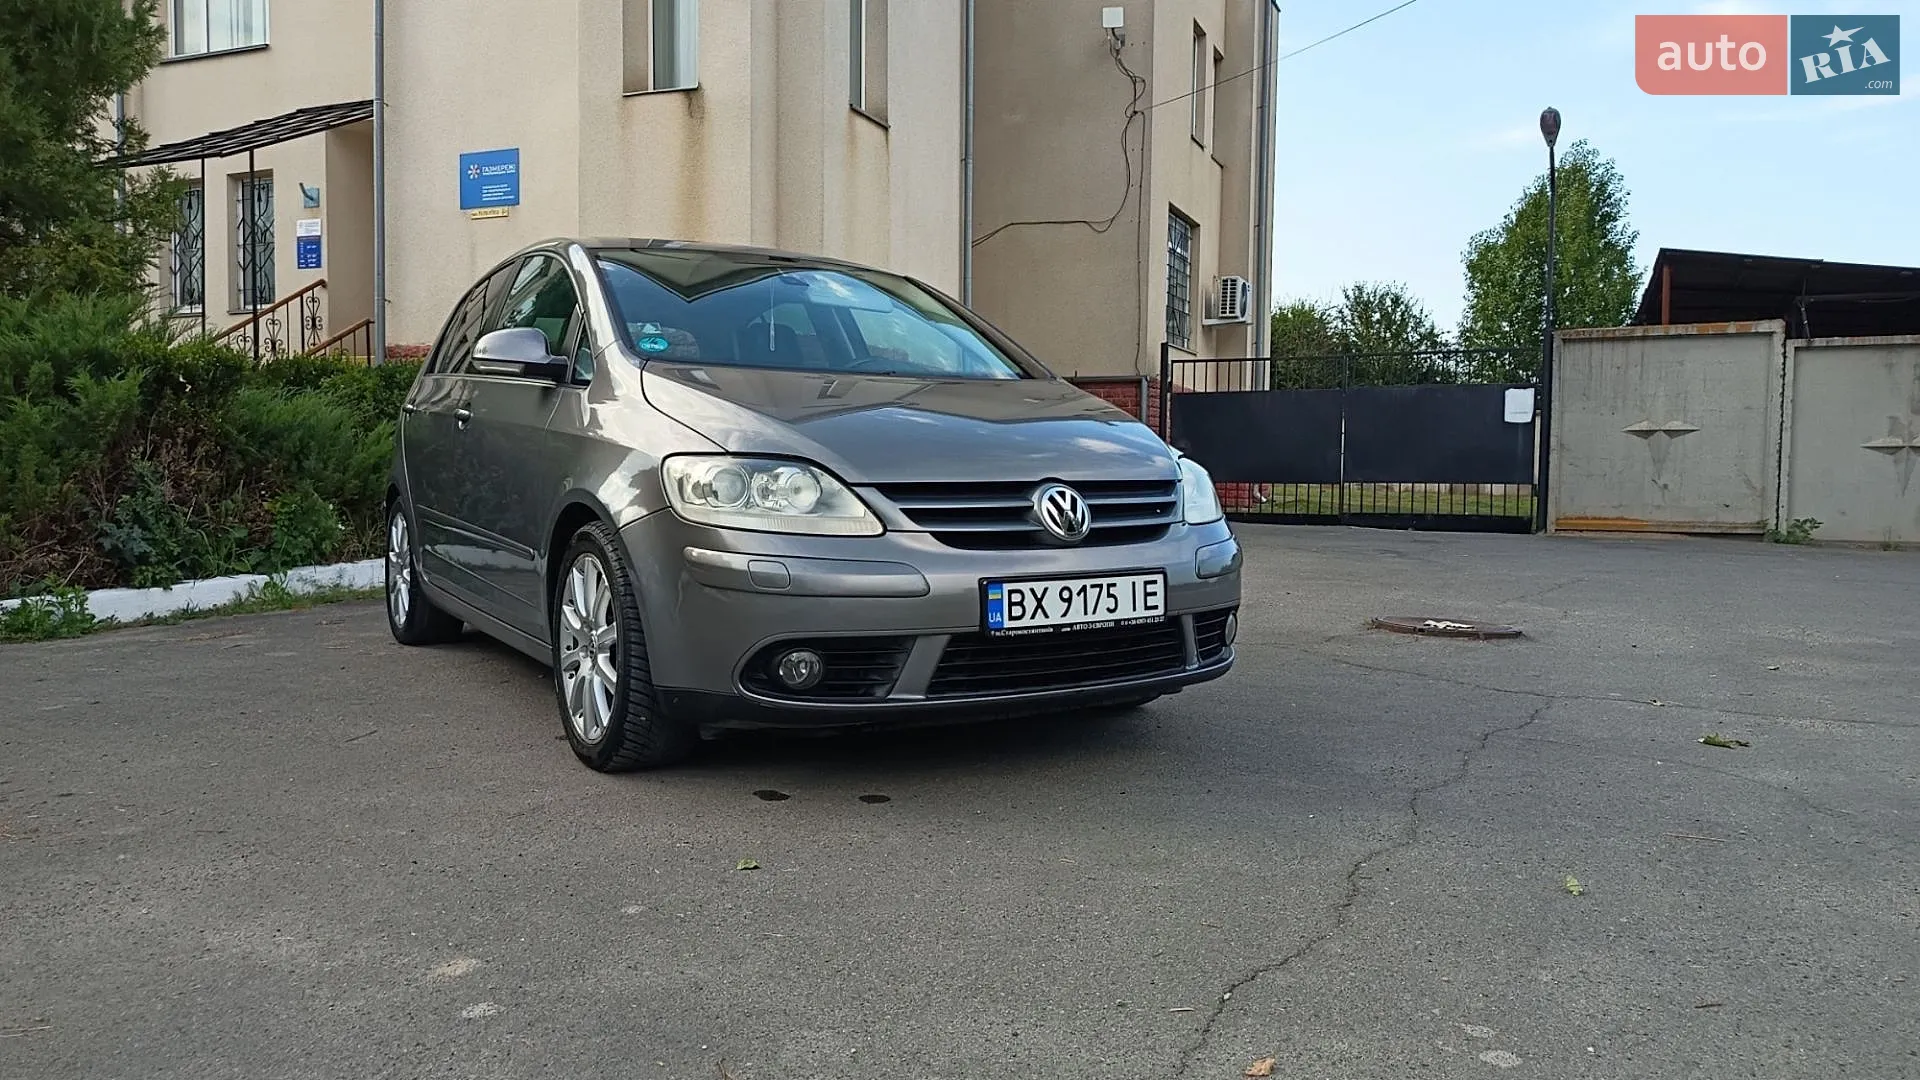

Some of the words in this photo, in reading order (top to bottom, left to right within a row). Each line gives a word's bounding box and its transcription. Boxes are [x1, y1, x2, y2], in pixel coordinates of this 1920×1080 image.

[1007, 586, 1050, 622] BX
[1058, 582, 1119, 618] 9175
[1132, 579, 1159, 612] IE
[988, 611, 1002, 623] UA
